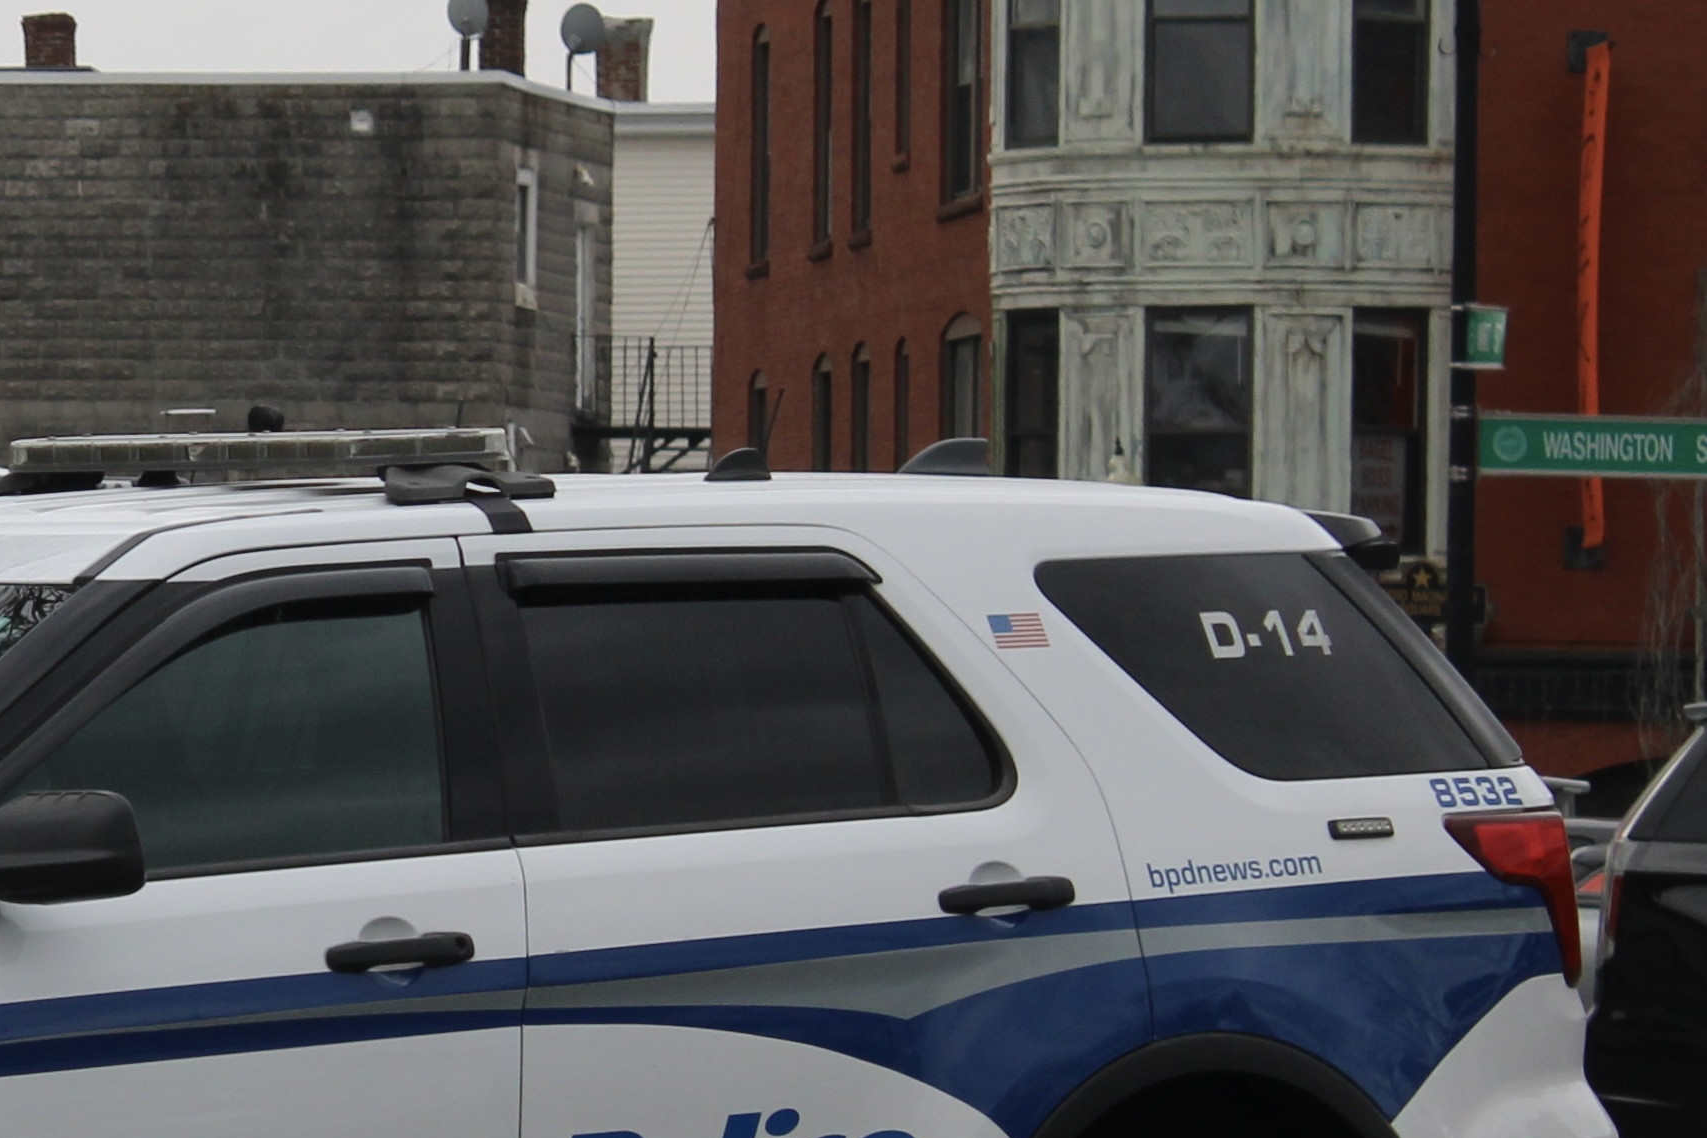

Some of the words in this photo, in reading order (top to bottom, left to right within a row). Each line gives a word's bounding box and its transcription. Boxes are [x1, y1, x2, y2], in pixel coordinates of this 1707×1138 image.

[1543, 431, 1674, 462] WASHINGTON
[1199, 609, 1333, 659] D-14
[1429, 776, 1523, 808] 8532
[1146, 855, 1323, 894] bpdnews.com
